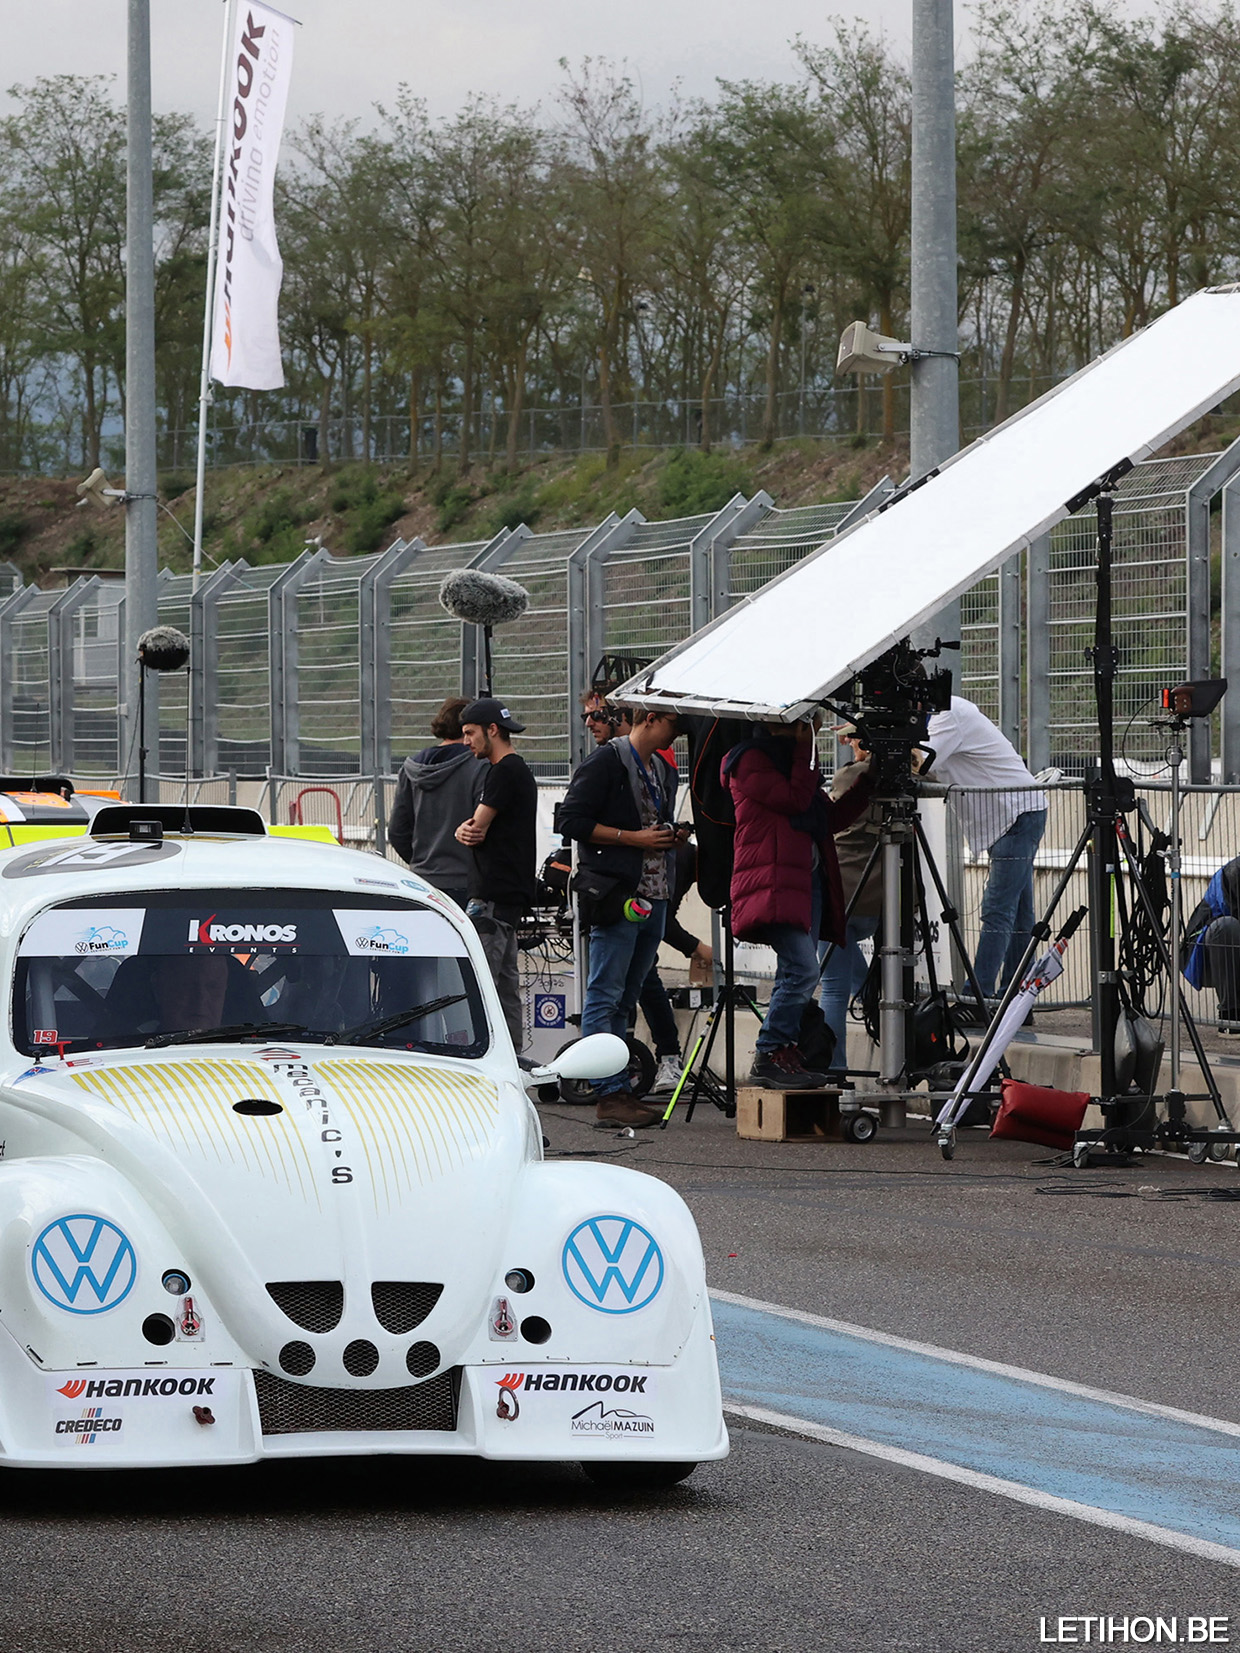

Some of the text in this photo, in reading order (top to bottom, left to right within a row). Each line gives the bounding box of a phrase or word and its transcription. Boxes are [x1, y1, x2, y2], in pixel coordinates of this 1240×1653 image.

[239, 28, 281, 242] driving emotion
[188, 914, 298, 944] KRONOS
[88, 939, 129, 950] FunCup
[189, 946, 298, 954] EVENTS
[369, 939, 410, 954] FunCup
[33, 1029, 58, 1044] 19
[55, 1418, 123, 1434] CREDECO
[605, 1431, 624, 1440] Sport
